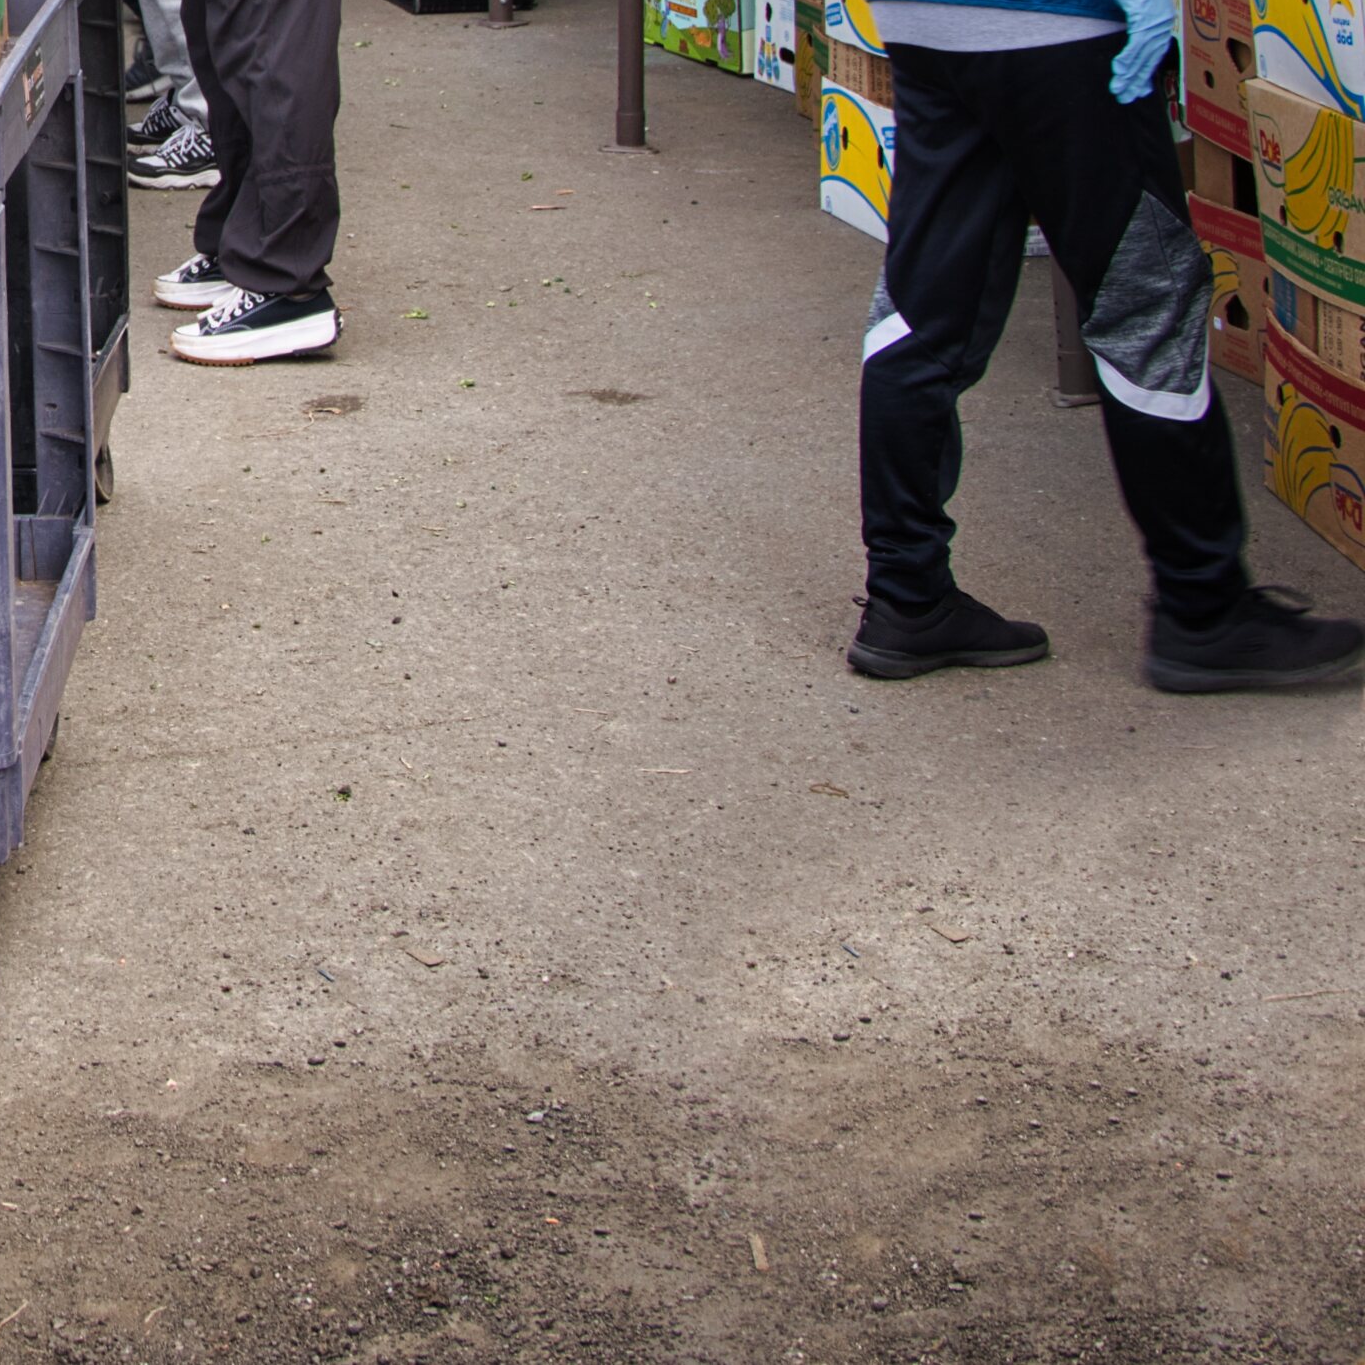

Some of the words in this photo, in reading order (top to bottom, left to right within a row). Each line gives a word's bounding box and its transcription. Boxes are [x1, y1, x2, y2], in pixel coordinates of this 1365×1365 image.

[1259, 128, 1282, 164] Dole
[1327, 185, 1365, 213] ORGAN
[1334, 486, 1364, 532] Dole
